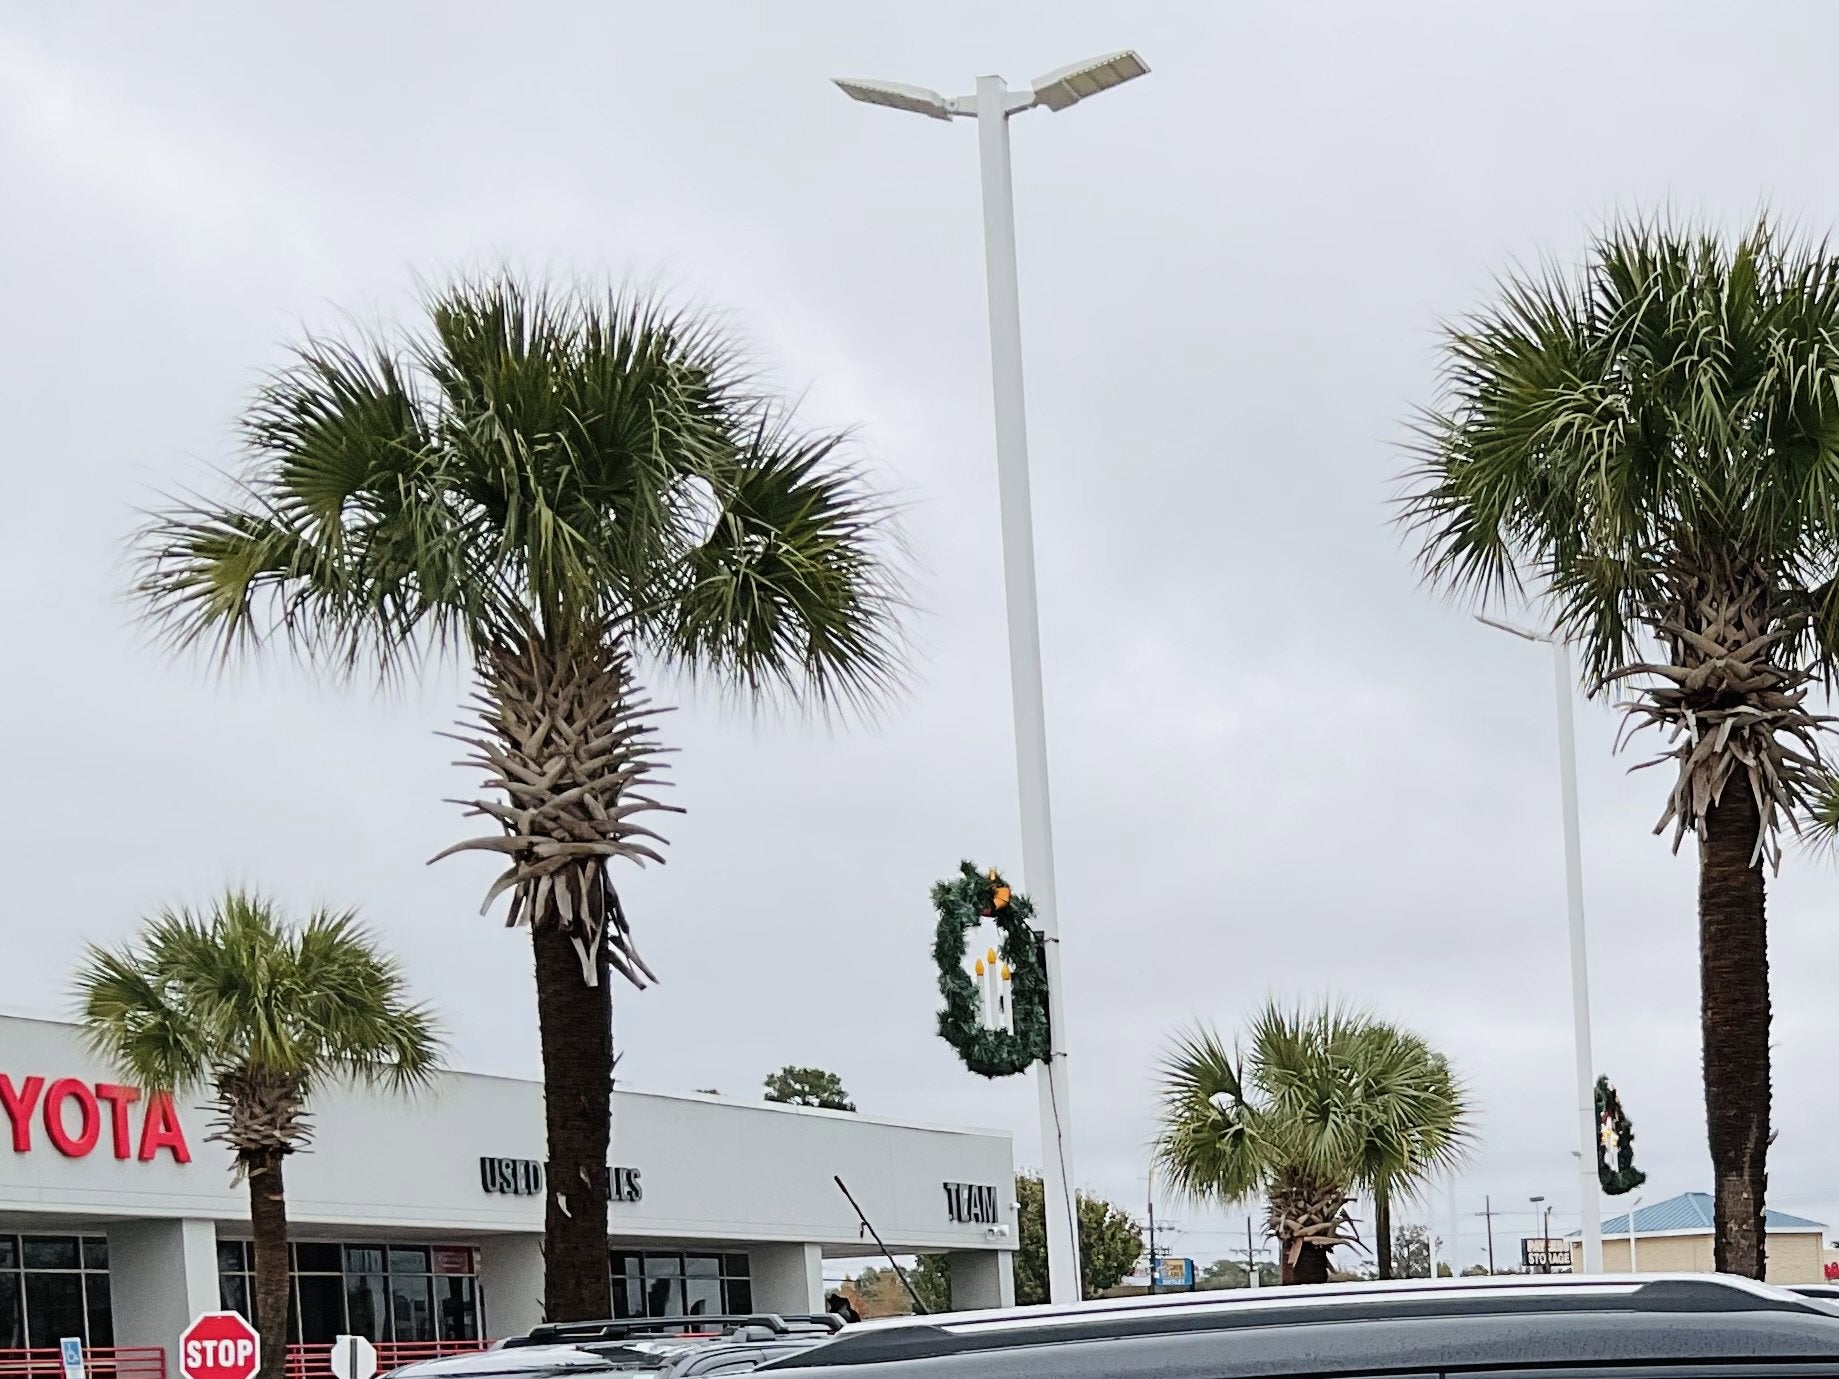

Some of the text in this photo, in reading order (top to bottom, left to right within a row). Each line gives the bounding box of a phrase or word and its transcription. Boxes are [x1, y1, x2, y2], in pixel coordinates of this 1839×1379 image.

[0, 1073, 192, 1164] YOTA
[480, 1157, 543, 1196] USED
[943, 1182, 998, 1223] TEAM
[186, 1338, 254, 1369] STOP
